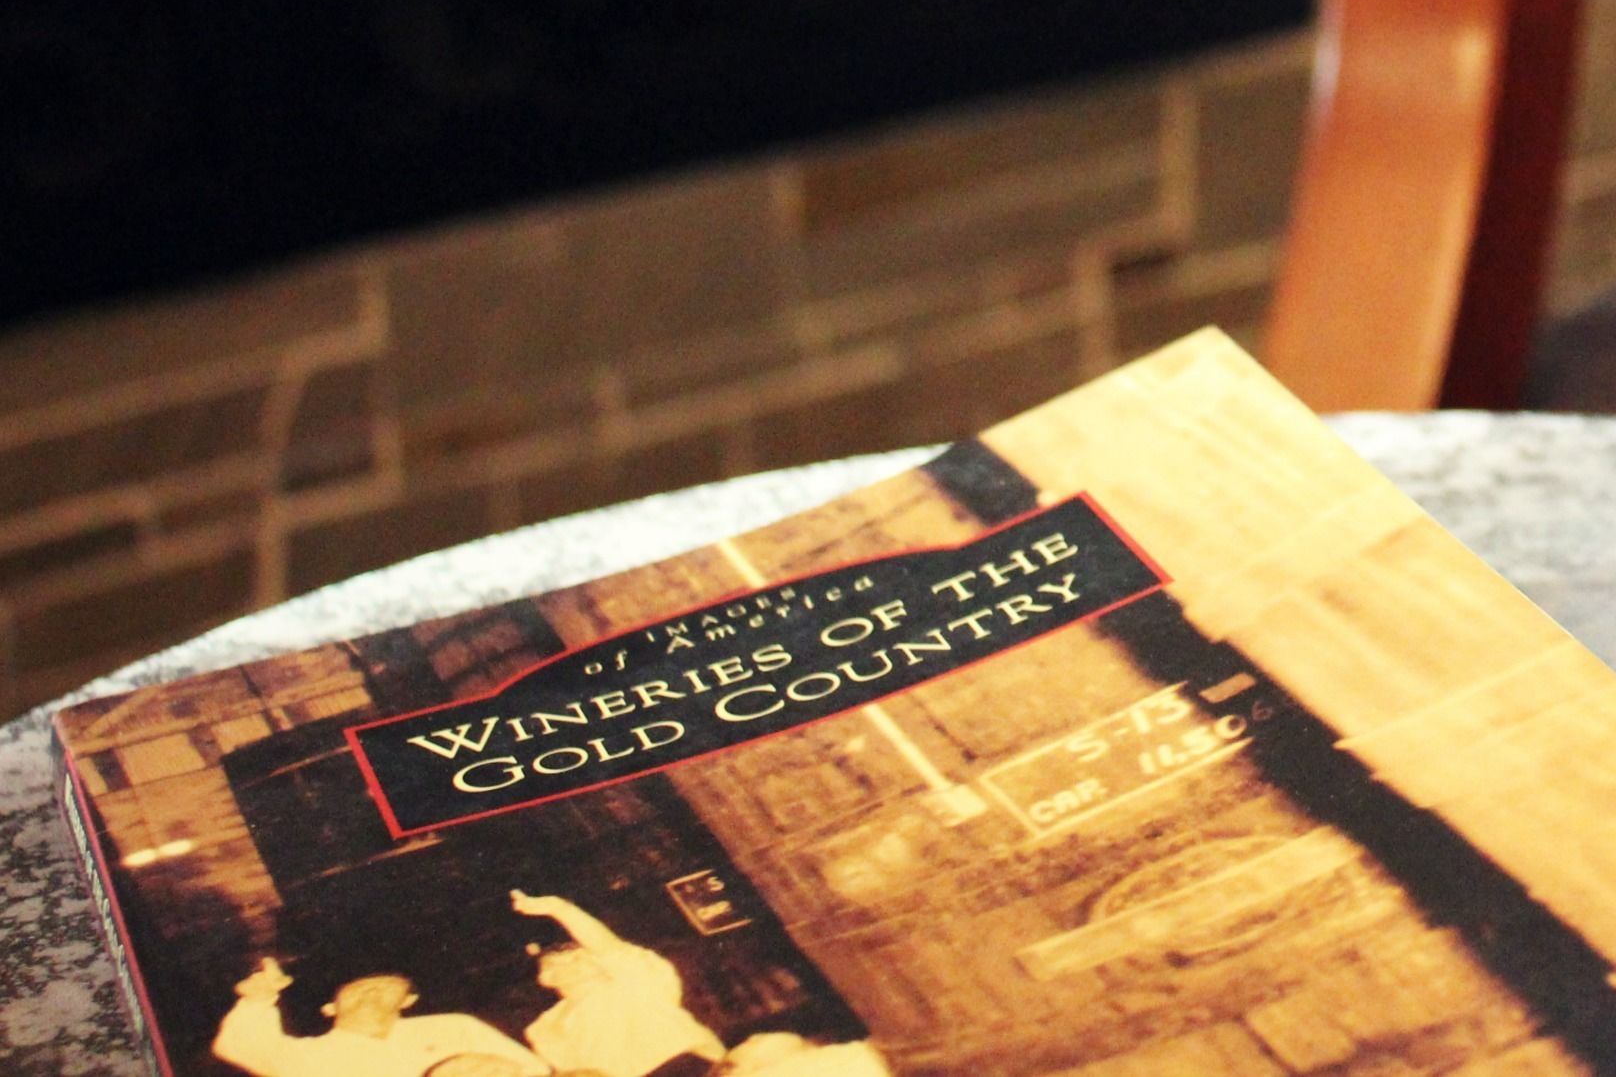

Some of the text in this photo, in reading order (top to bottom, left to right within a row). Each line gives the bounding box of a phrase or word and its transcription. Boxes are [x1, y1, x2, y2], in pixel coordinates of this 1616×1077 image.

[407, 532, 1079, 760] WINERIES OF THE
[451, 572, 1081, 793] GOLD COUNTRY
[584, 648, 628, 676] of
